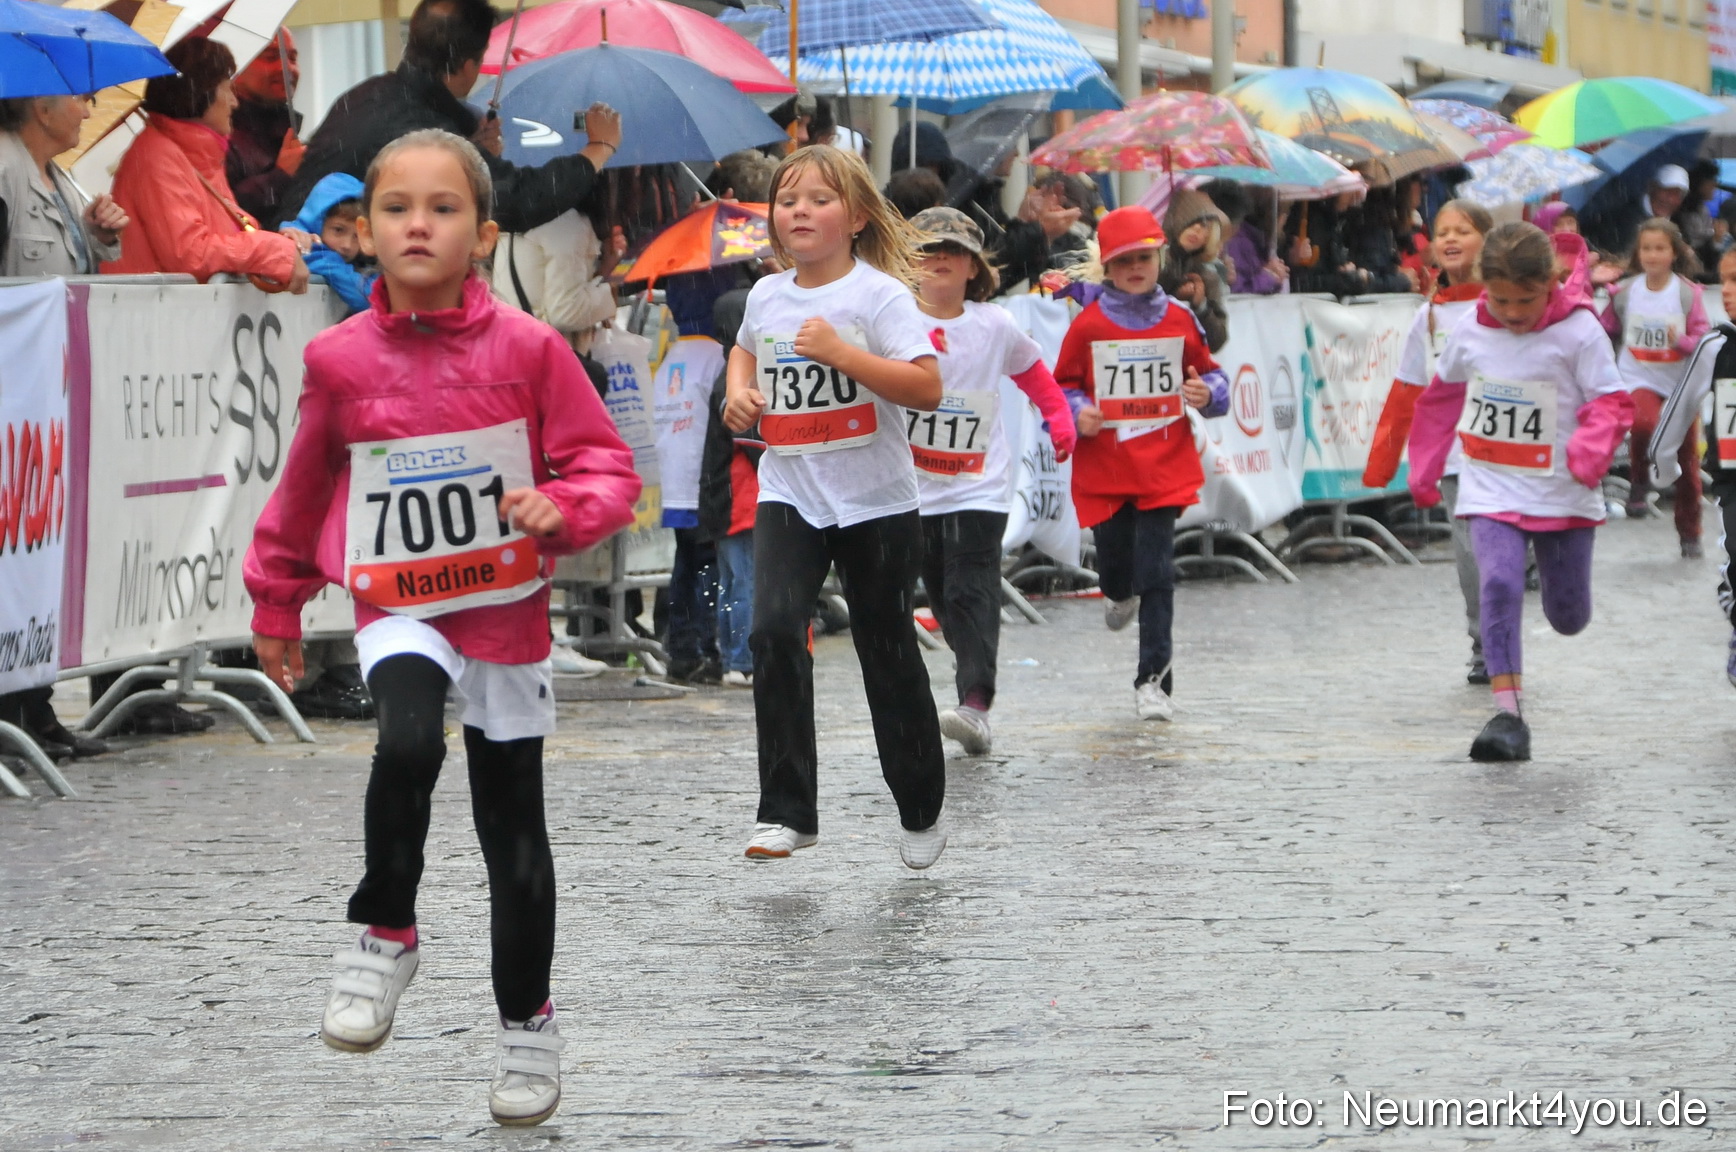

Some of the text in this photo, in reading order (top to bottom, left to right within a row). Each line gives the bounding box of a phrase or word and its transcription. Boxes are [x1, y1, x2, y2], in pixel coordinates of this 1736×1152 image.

[1633, 326, 1666, 348] 709
[764, 364, 857, 410] 7320
[1104, 362, 1173, 395] 7115
[122, 371, 221, 440] RECHTS
[1122, 402, 1159, 416] Maria
[1470, 397, 1544, 441] 7314
[775, 416, 834, 445] Cindy
[906, 409, 981, 450] 7117
[387, 446, 468, 473] BOCK
[914, 450, 966, 473] Hannah
[366, 474, 511, 556] 7001
[396, 562, 496, 598] Nadine
